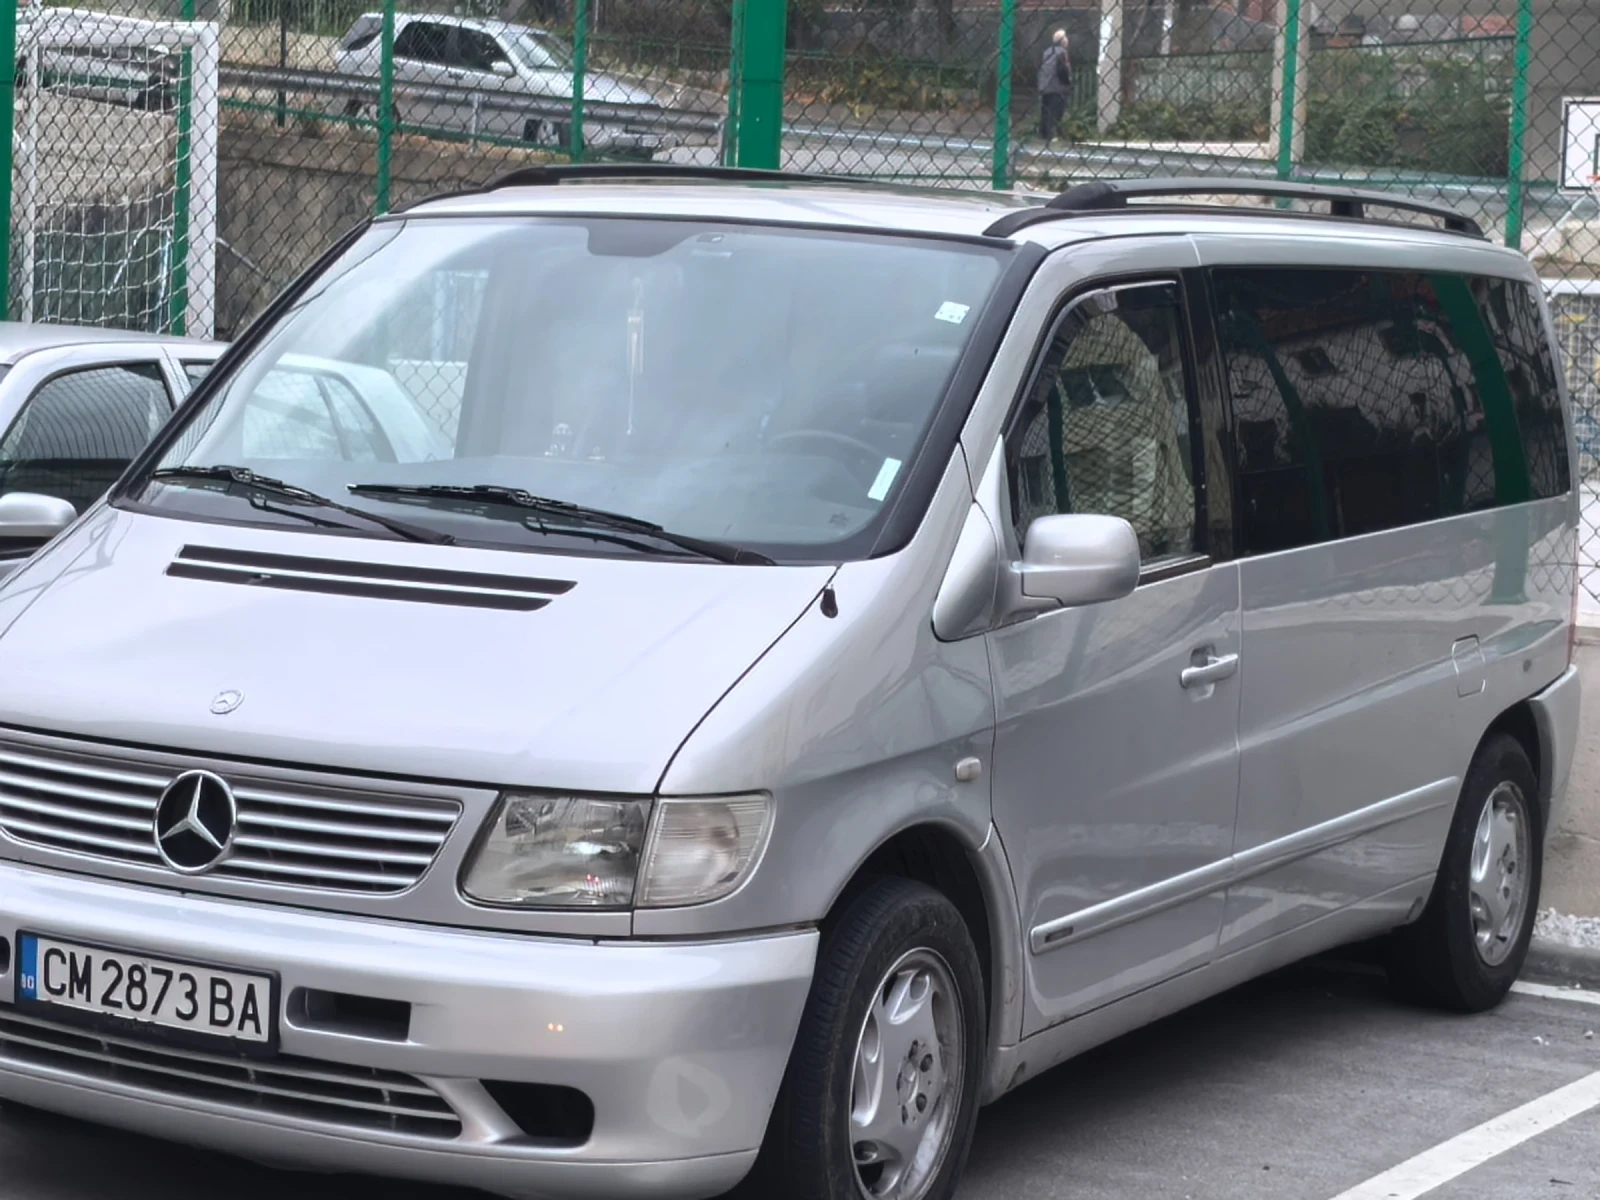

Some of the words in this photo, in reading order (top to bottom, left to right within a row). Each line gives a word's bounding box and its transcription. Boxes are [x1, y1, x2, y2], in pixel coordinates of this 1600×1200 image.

[43, 948, 92, 1003] CM
[100, 959, 199, 1021] 2873
[209, 977, 262, 1035] BA
